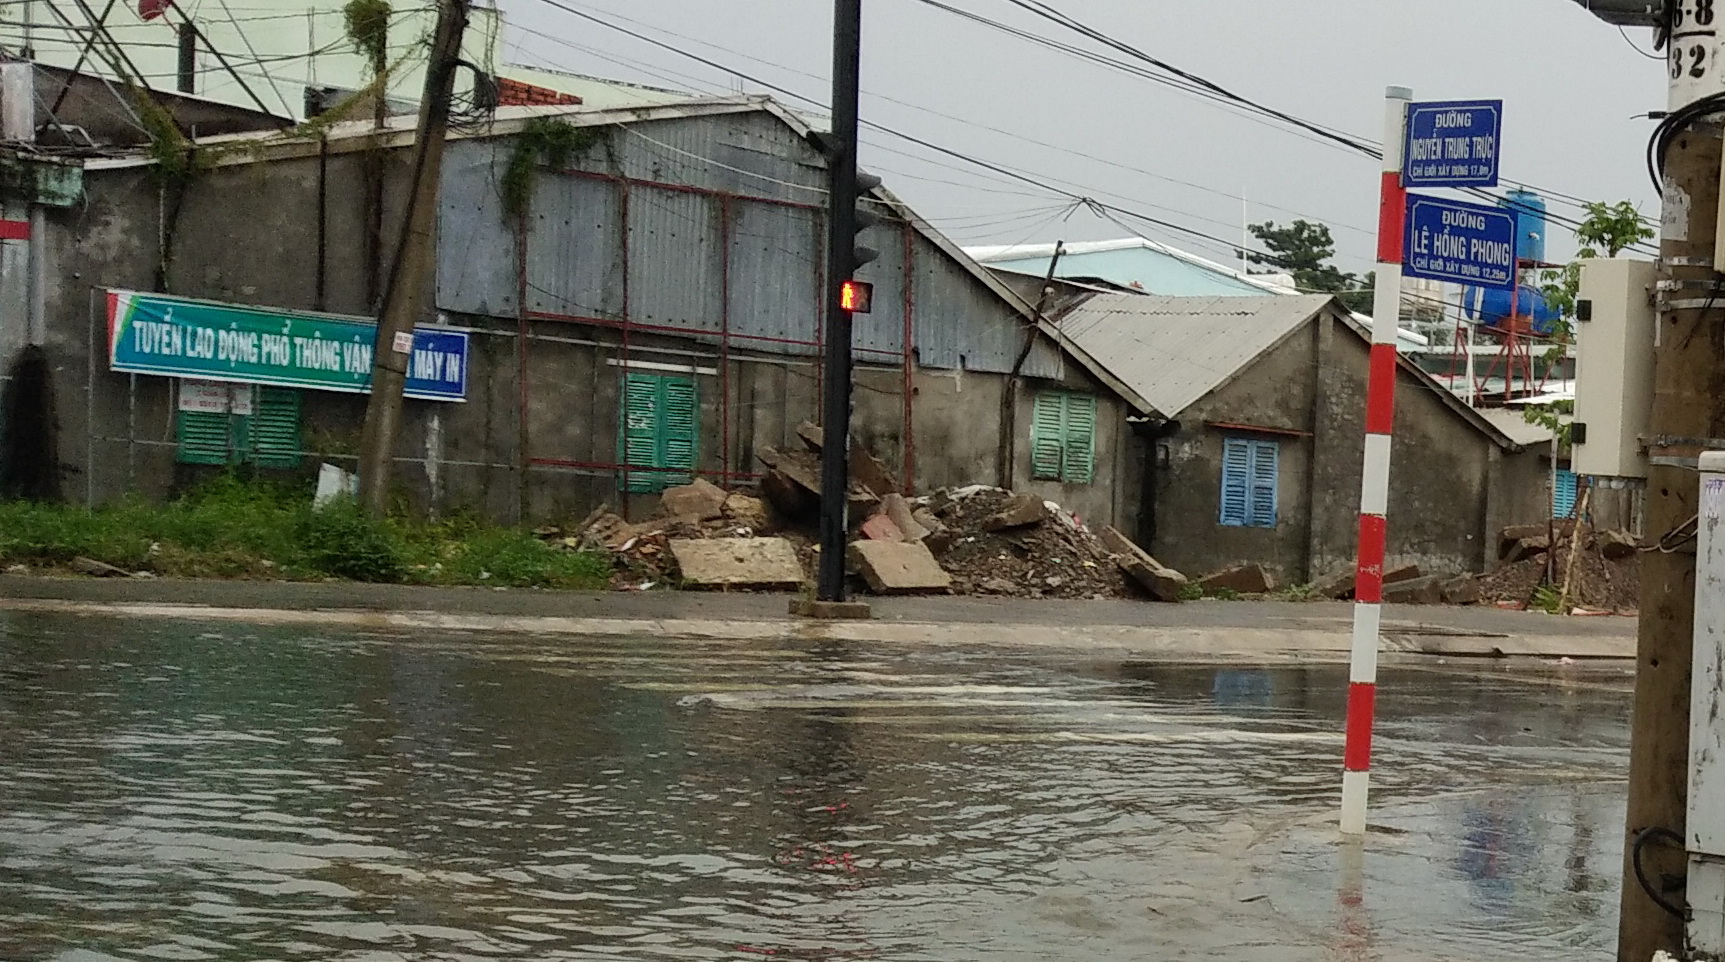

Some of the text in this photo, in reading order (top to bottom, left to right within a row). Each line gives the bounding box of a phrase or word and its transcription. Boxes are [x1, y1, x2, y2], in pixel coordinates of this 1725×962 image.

[1435, 110, 1472, 128] ĐƯỜNG
[1412, 128, 1493, 162] NGUYỄN TRUNG TRỰC
[1437, 163, 1450, 176] XÂY
[1441, 210, 1486, 231] ĐƯỜNG
[1414, 225, 1510, 266] LÊ HỒNG PHONG
[1445, 260, 1460, 273] XÂY
[132, 307, 182, 356] TUYỂN
[186, 325, 215, 359] LAO
[218, 322, 258, 367] ĐỘNG
[261, 320, 290, 366] PHỔ
[293, 330, 340, 371] THÔNG
[343, 335, 371, 379] VẬN
[414, 342, 444, 381] MÁY
[446, 353, 460, 382] IN
